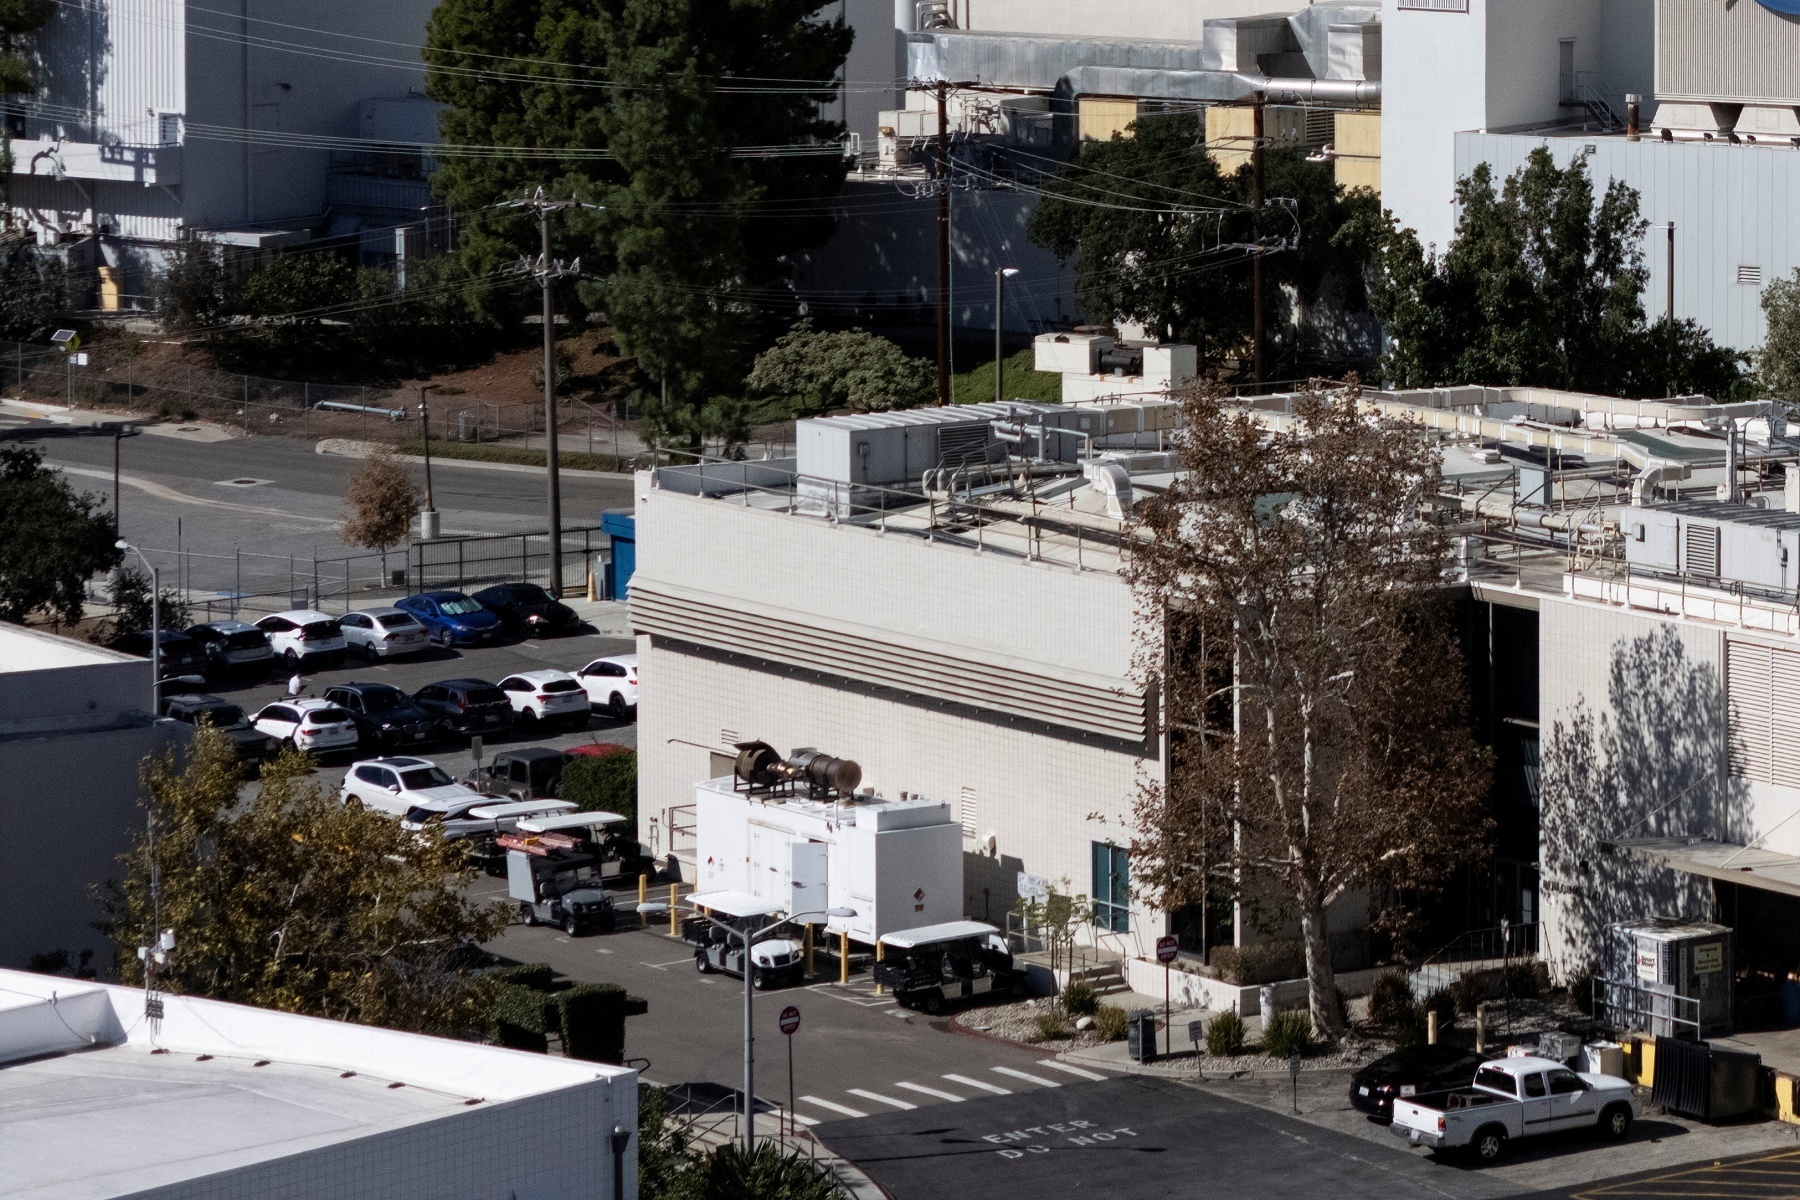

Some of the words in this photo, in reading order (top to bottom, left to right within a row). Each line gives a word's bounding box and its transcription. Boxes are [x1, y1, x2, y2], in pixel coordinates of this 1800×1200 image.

[981, 1120, 1098, 1144] ENTER
[996, 1145, 1050, 1159] DO
[1068, 1127, 1138, 1146] NOT
